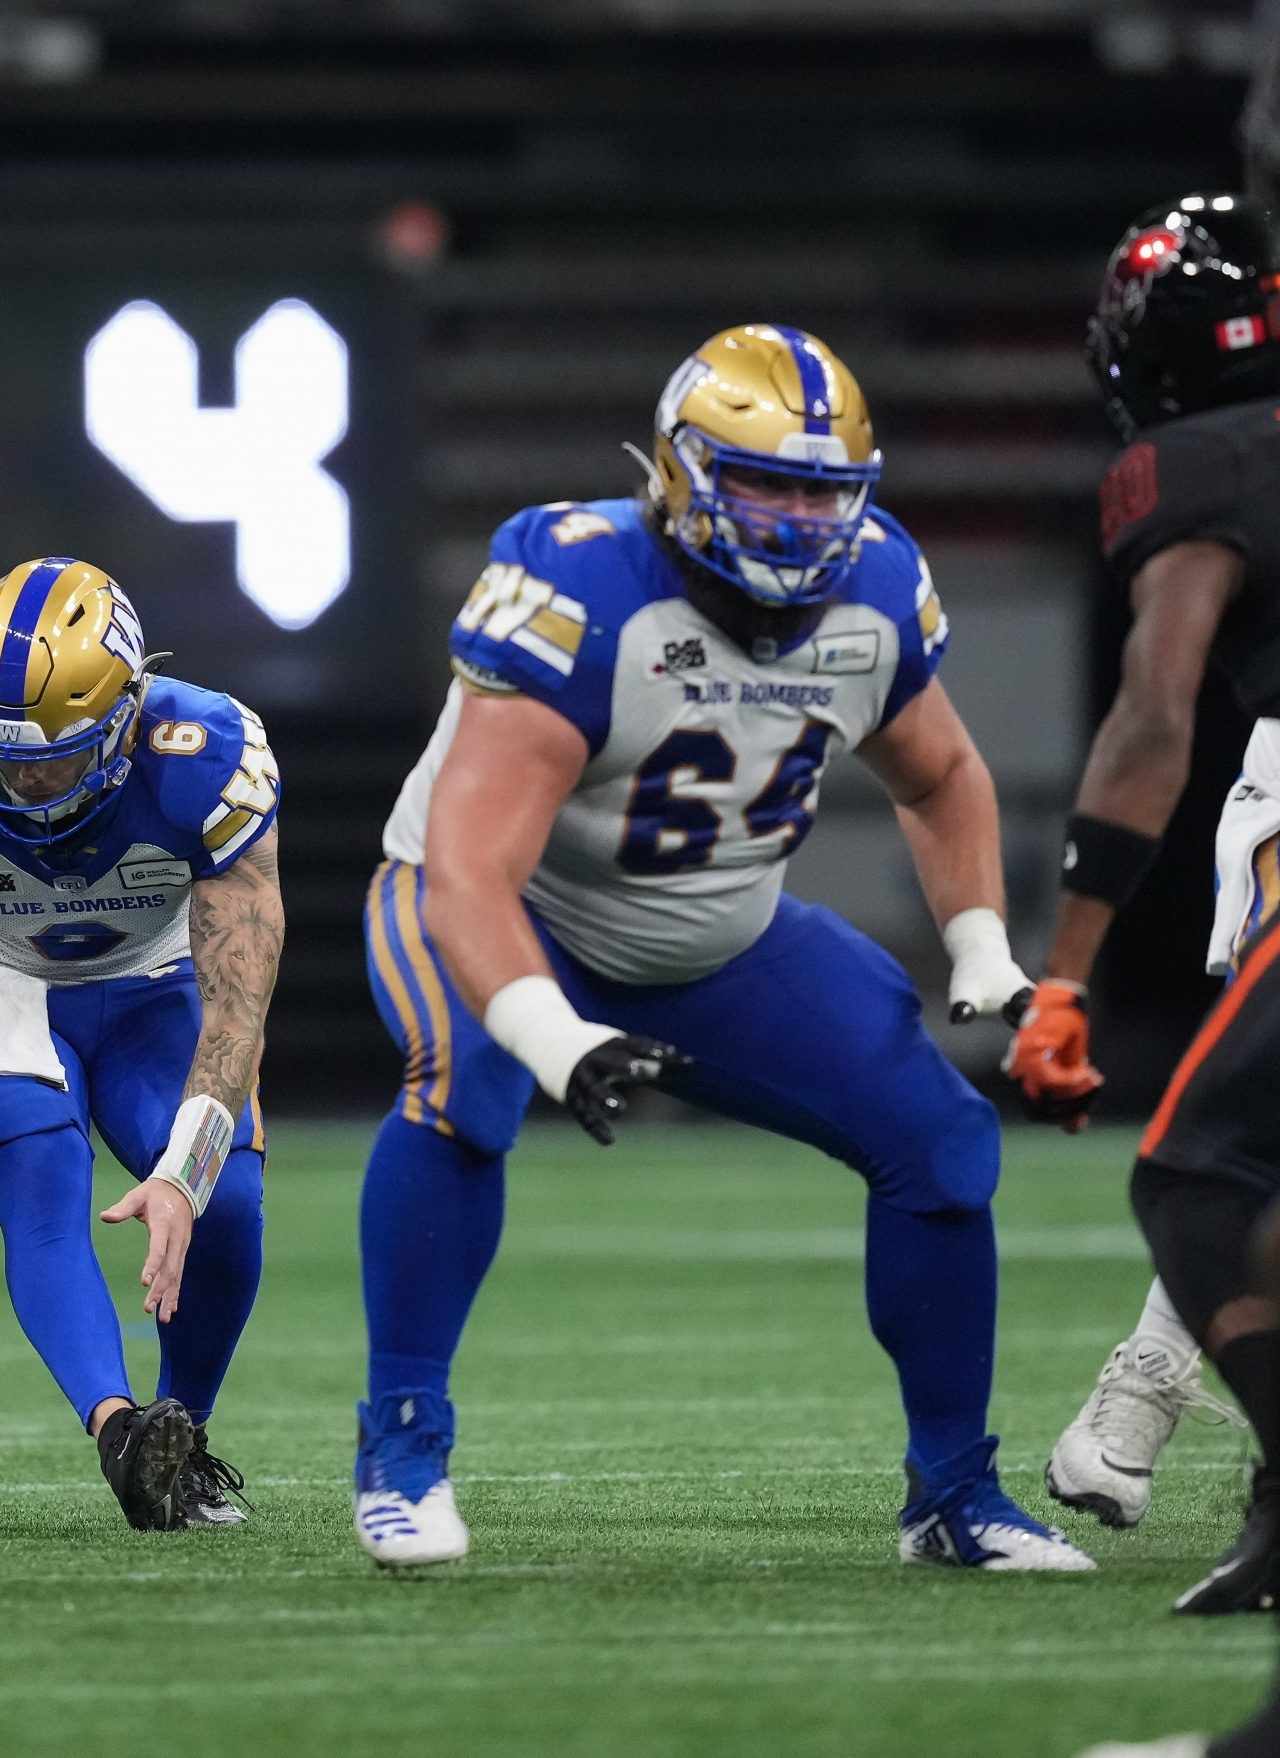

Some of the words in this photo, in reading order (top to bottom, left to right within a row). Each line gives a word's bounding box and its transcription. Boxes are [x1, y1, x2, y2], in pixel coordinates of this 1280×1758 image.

[83, 298, 351, 631] 4
[741, 682, 834, 707] BOMBERS
[149, 720, 207, 755] 6
[615, 719, 832, 875] 64
[132, 871, 145, 880] IG
[53, 894, 166, 913] BOMBERS
